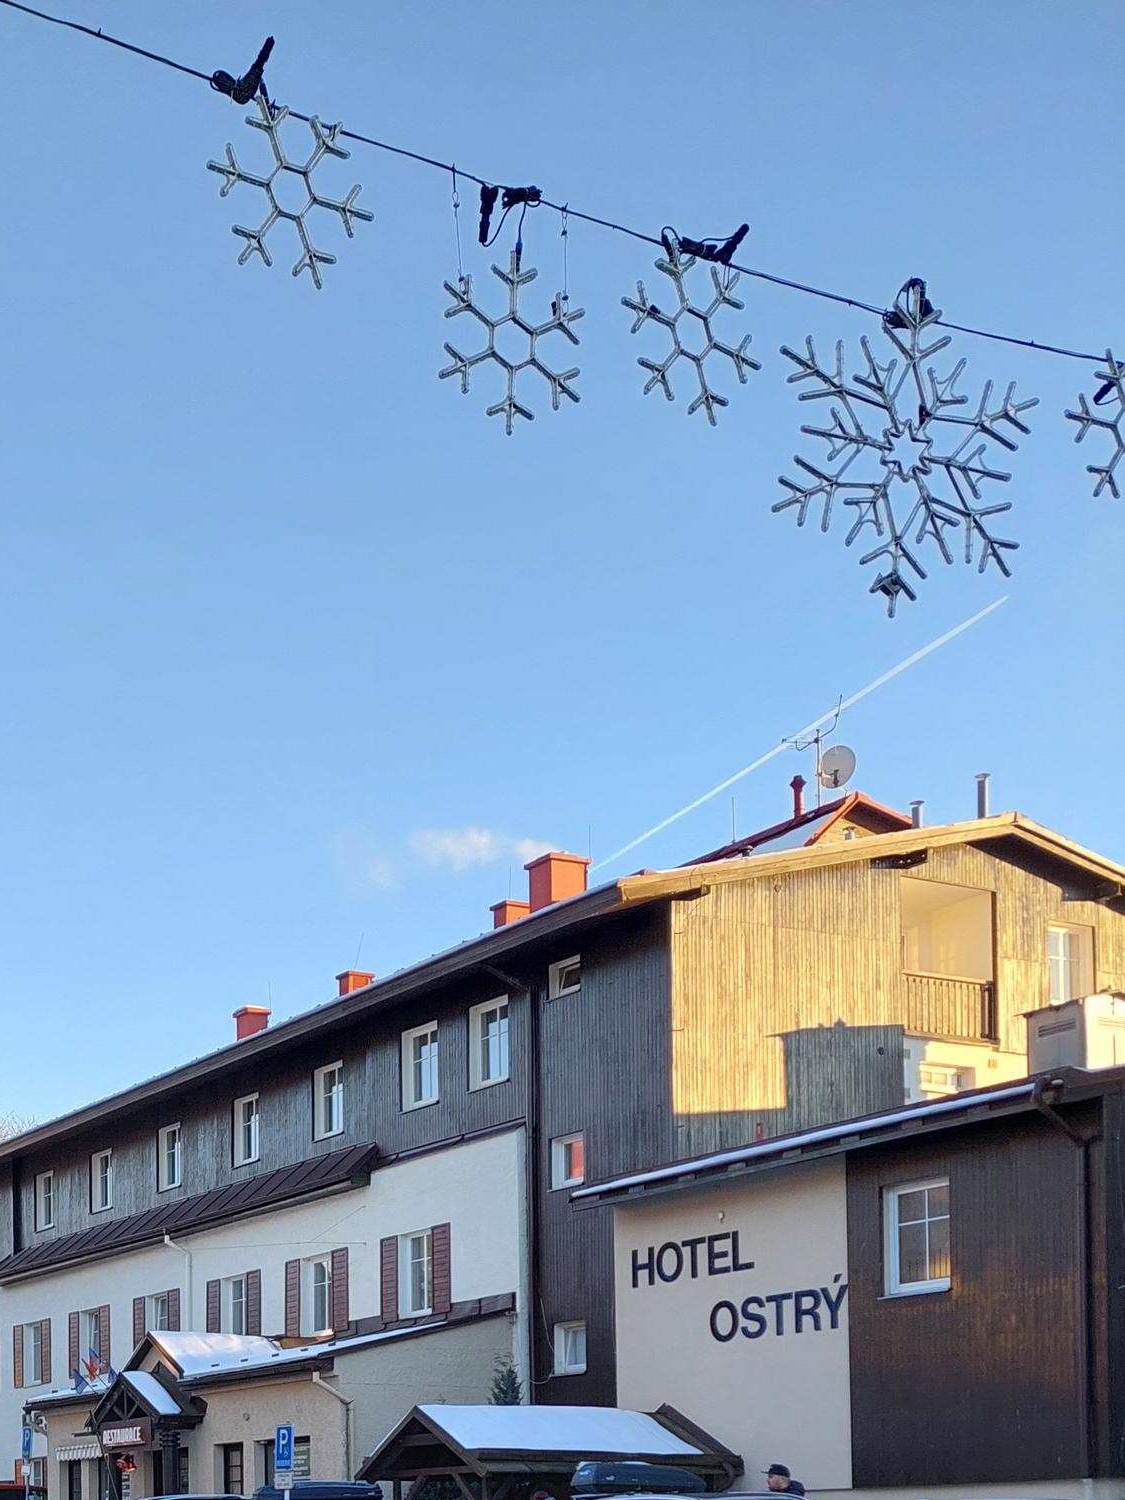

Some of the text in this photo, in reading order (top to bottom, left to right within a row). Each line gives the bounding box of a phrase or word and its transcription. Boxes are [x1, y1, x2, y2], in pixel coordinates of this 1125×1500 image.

[631, 1230, 755, 1289] HOTEL
[709, 1273, 849, 1343] OSTRÝ
[279, 1429, 289, 1455] P
